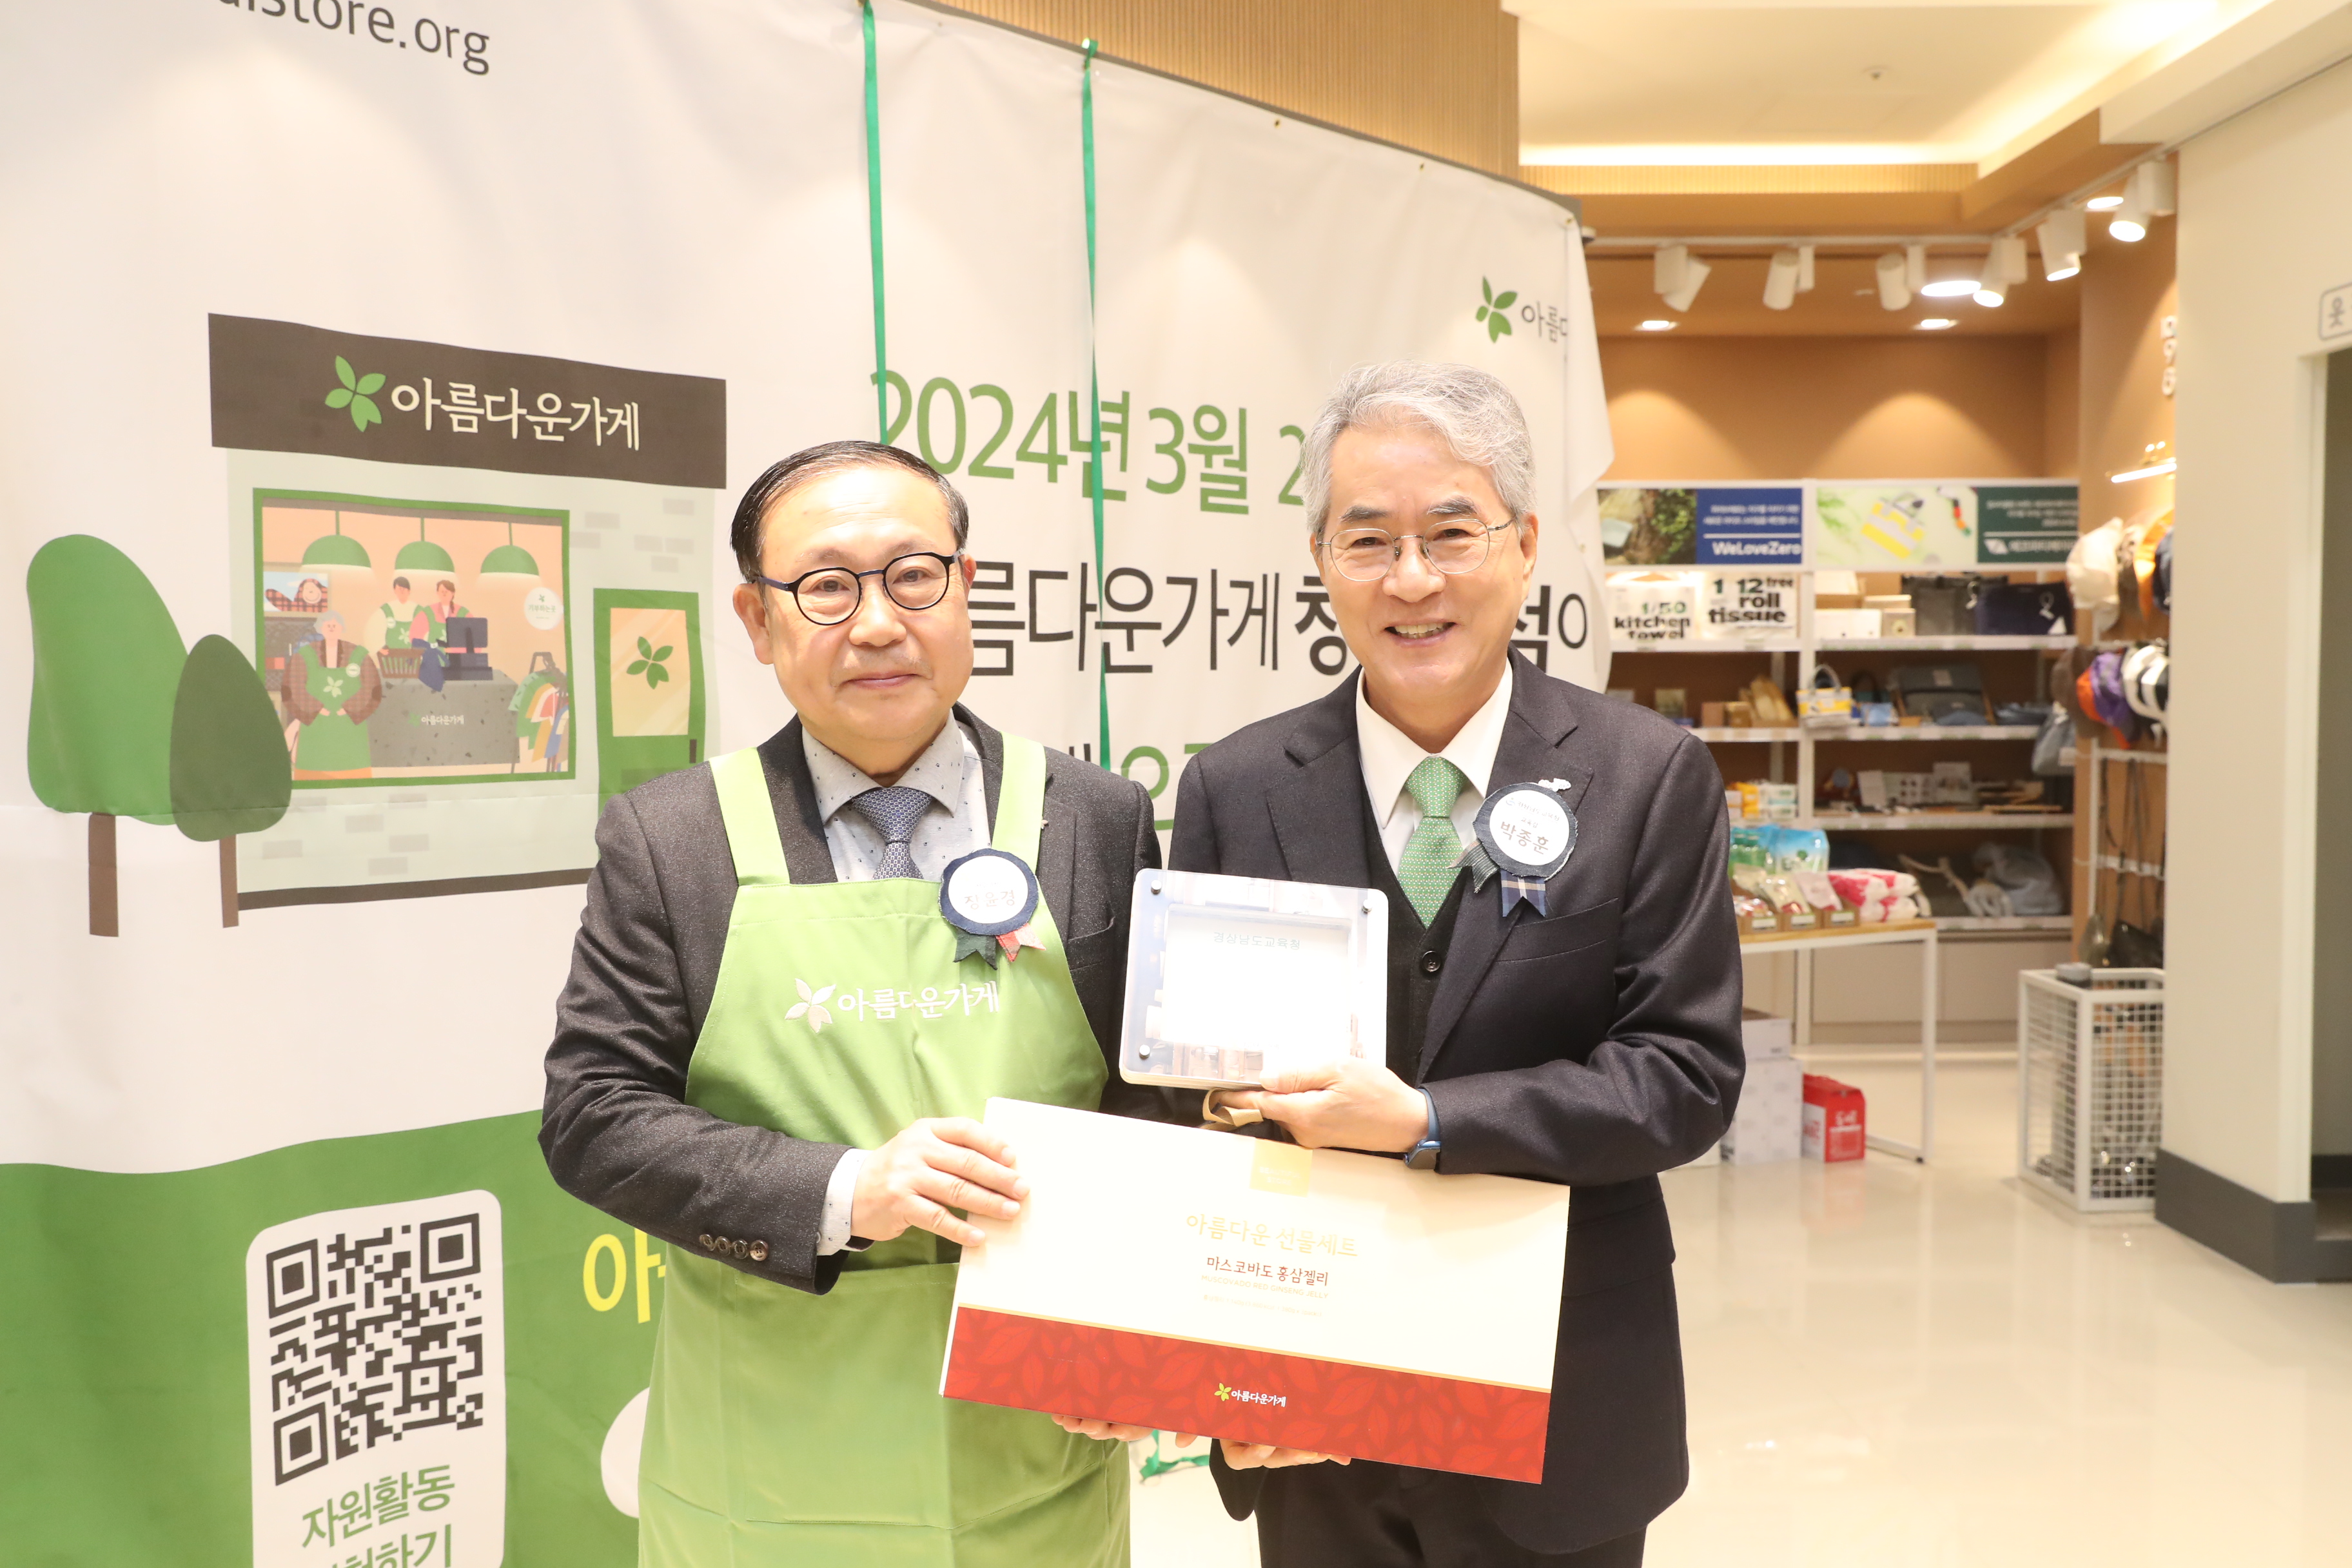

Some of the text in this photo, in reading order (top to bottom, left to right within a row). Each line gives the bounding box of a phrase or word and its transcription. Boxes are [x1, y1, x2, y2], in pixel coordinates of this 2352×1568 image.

[391, 377, 641, 451] 아름다운가게
[870, 369, 1130, 503] 2024년
[1146, 404, 1250, 515] 3월
[1708, 607, 1787, 623] tissue
[1740, 593, 1781, 608] roll
[967, 562, 1280, 676] 름다운가게
[1614, 616, 1690, 628] kitchen
[420, 714, 464, 726] 아름다운가게
[1500, 821, 1549, 855] 박종훈
[1213, 932, 1301, 950] 경상남도교육청
[838, 980, 999, 1023] 아름다운가게
[1186, 1213, 1358, 1257] 아름다운 선물세트
[582, 1226, 667, 1324] 아
[1201, 1275, 1329, 1299] MUSCOVADO RED GINSENG JELLY
[1206, 1256, 1329, 1287] 마스코바도 홍삼젤리
[1231, 1389, 1287, 1407] 아름다운가게
[302, 1464, 455, 1548] 자원활동
[332, 1523, 451, 1568] 하기
